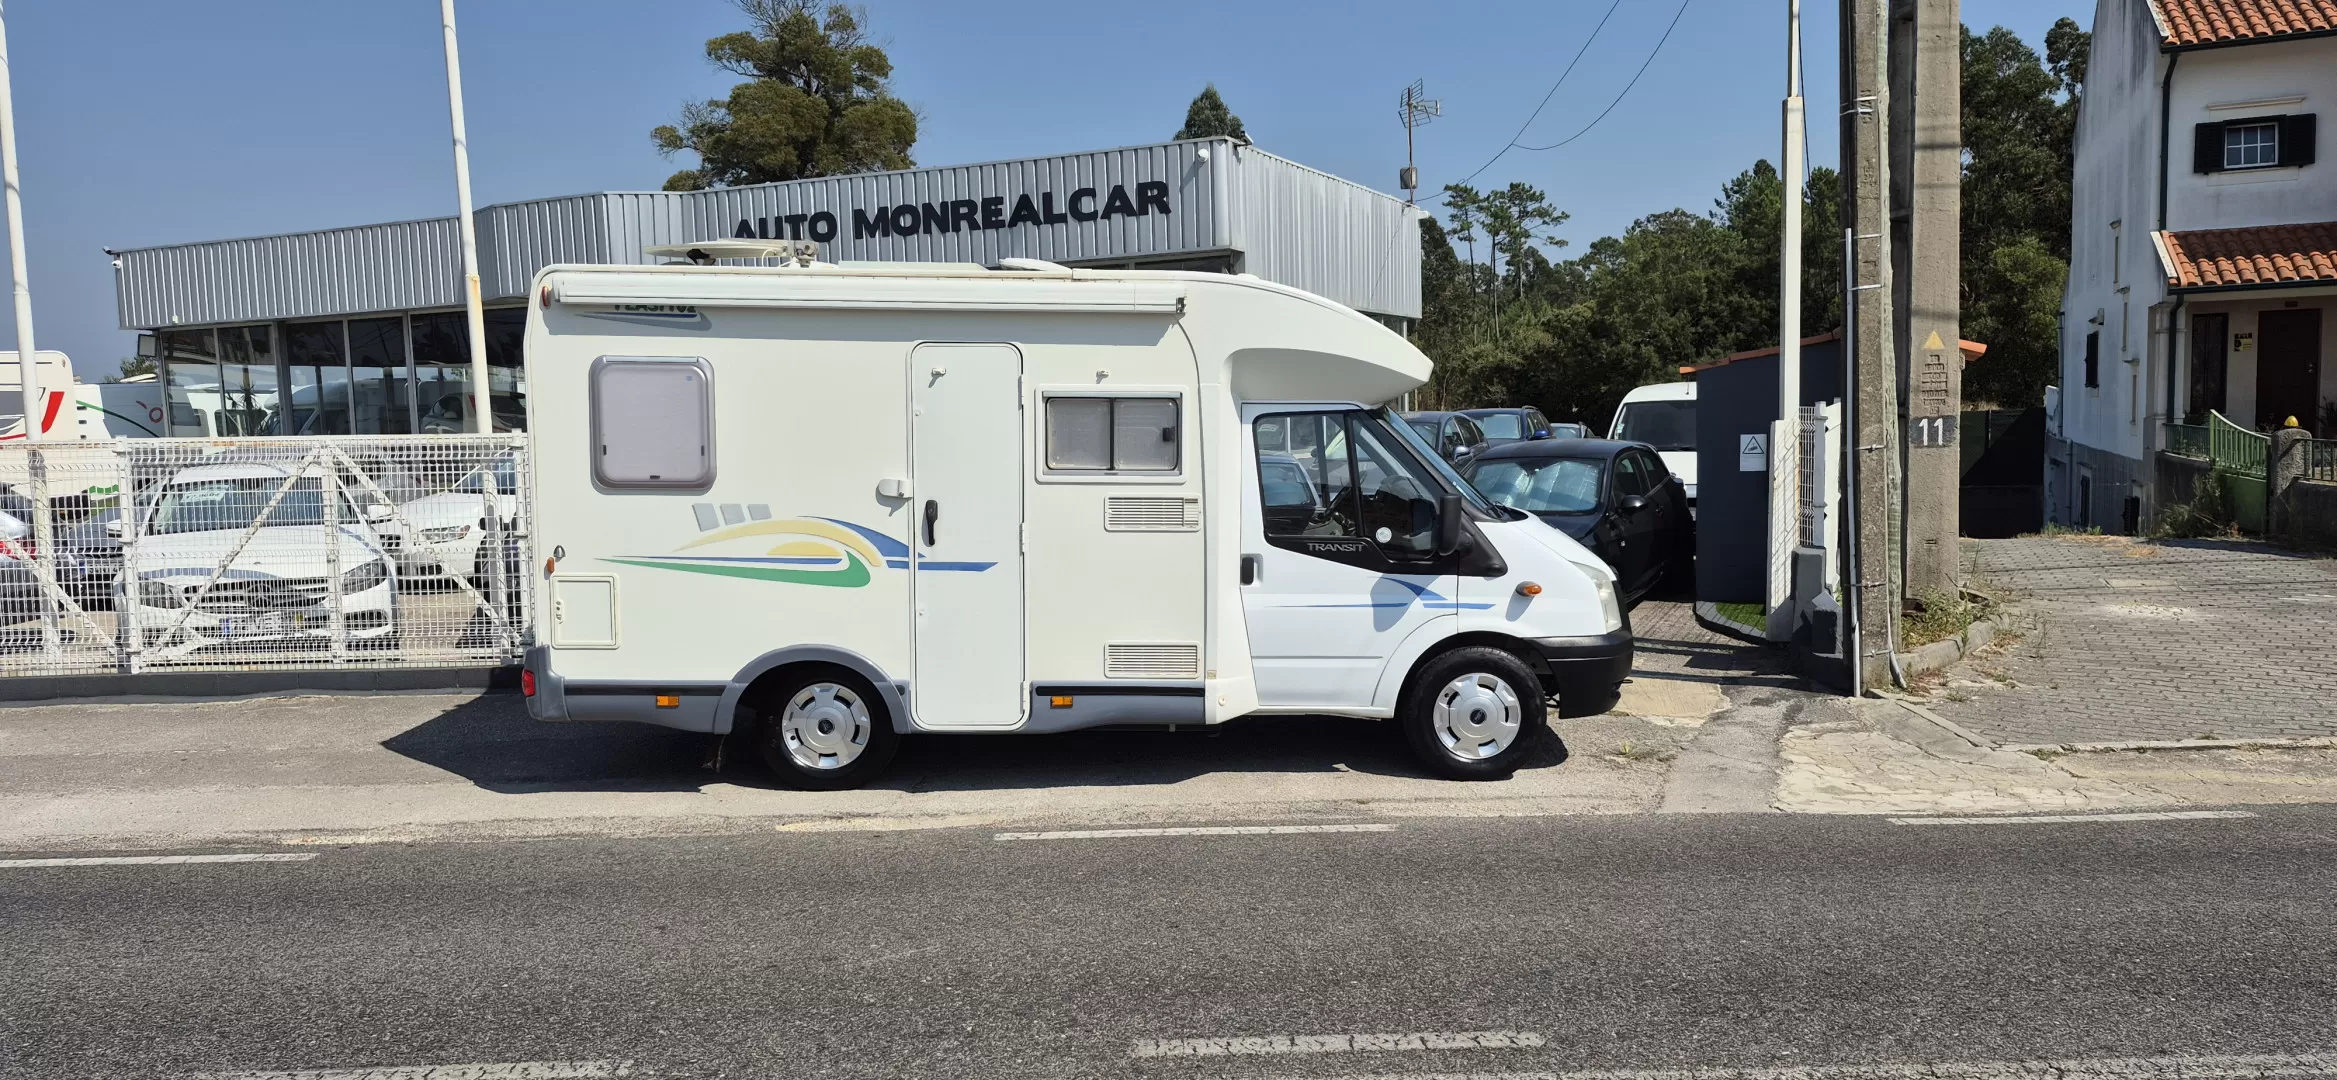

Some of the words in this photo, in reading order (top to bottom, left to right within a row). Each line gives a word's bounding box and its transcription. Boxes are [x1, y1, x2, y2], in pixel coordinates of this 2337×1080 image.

[734, 211, 838, 243] AUTO
[853, 180, 1172, 240] MONREALCAR
[1918, 417, 1943, 446] 11
[1307, 543, 1365, 552] TRANSIT
